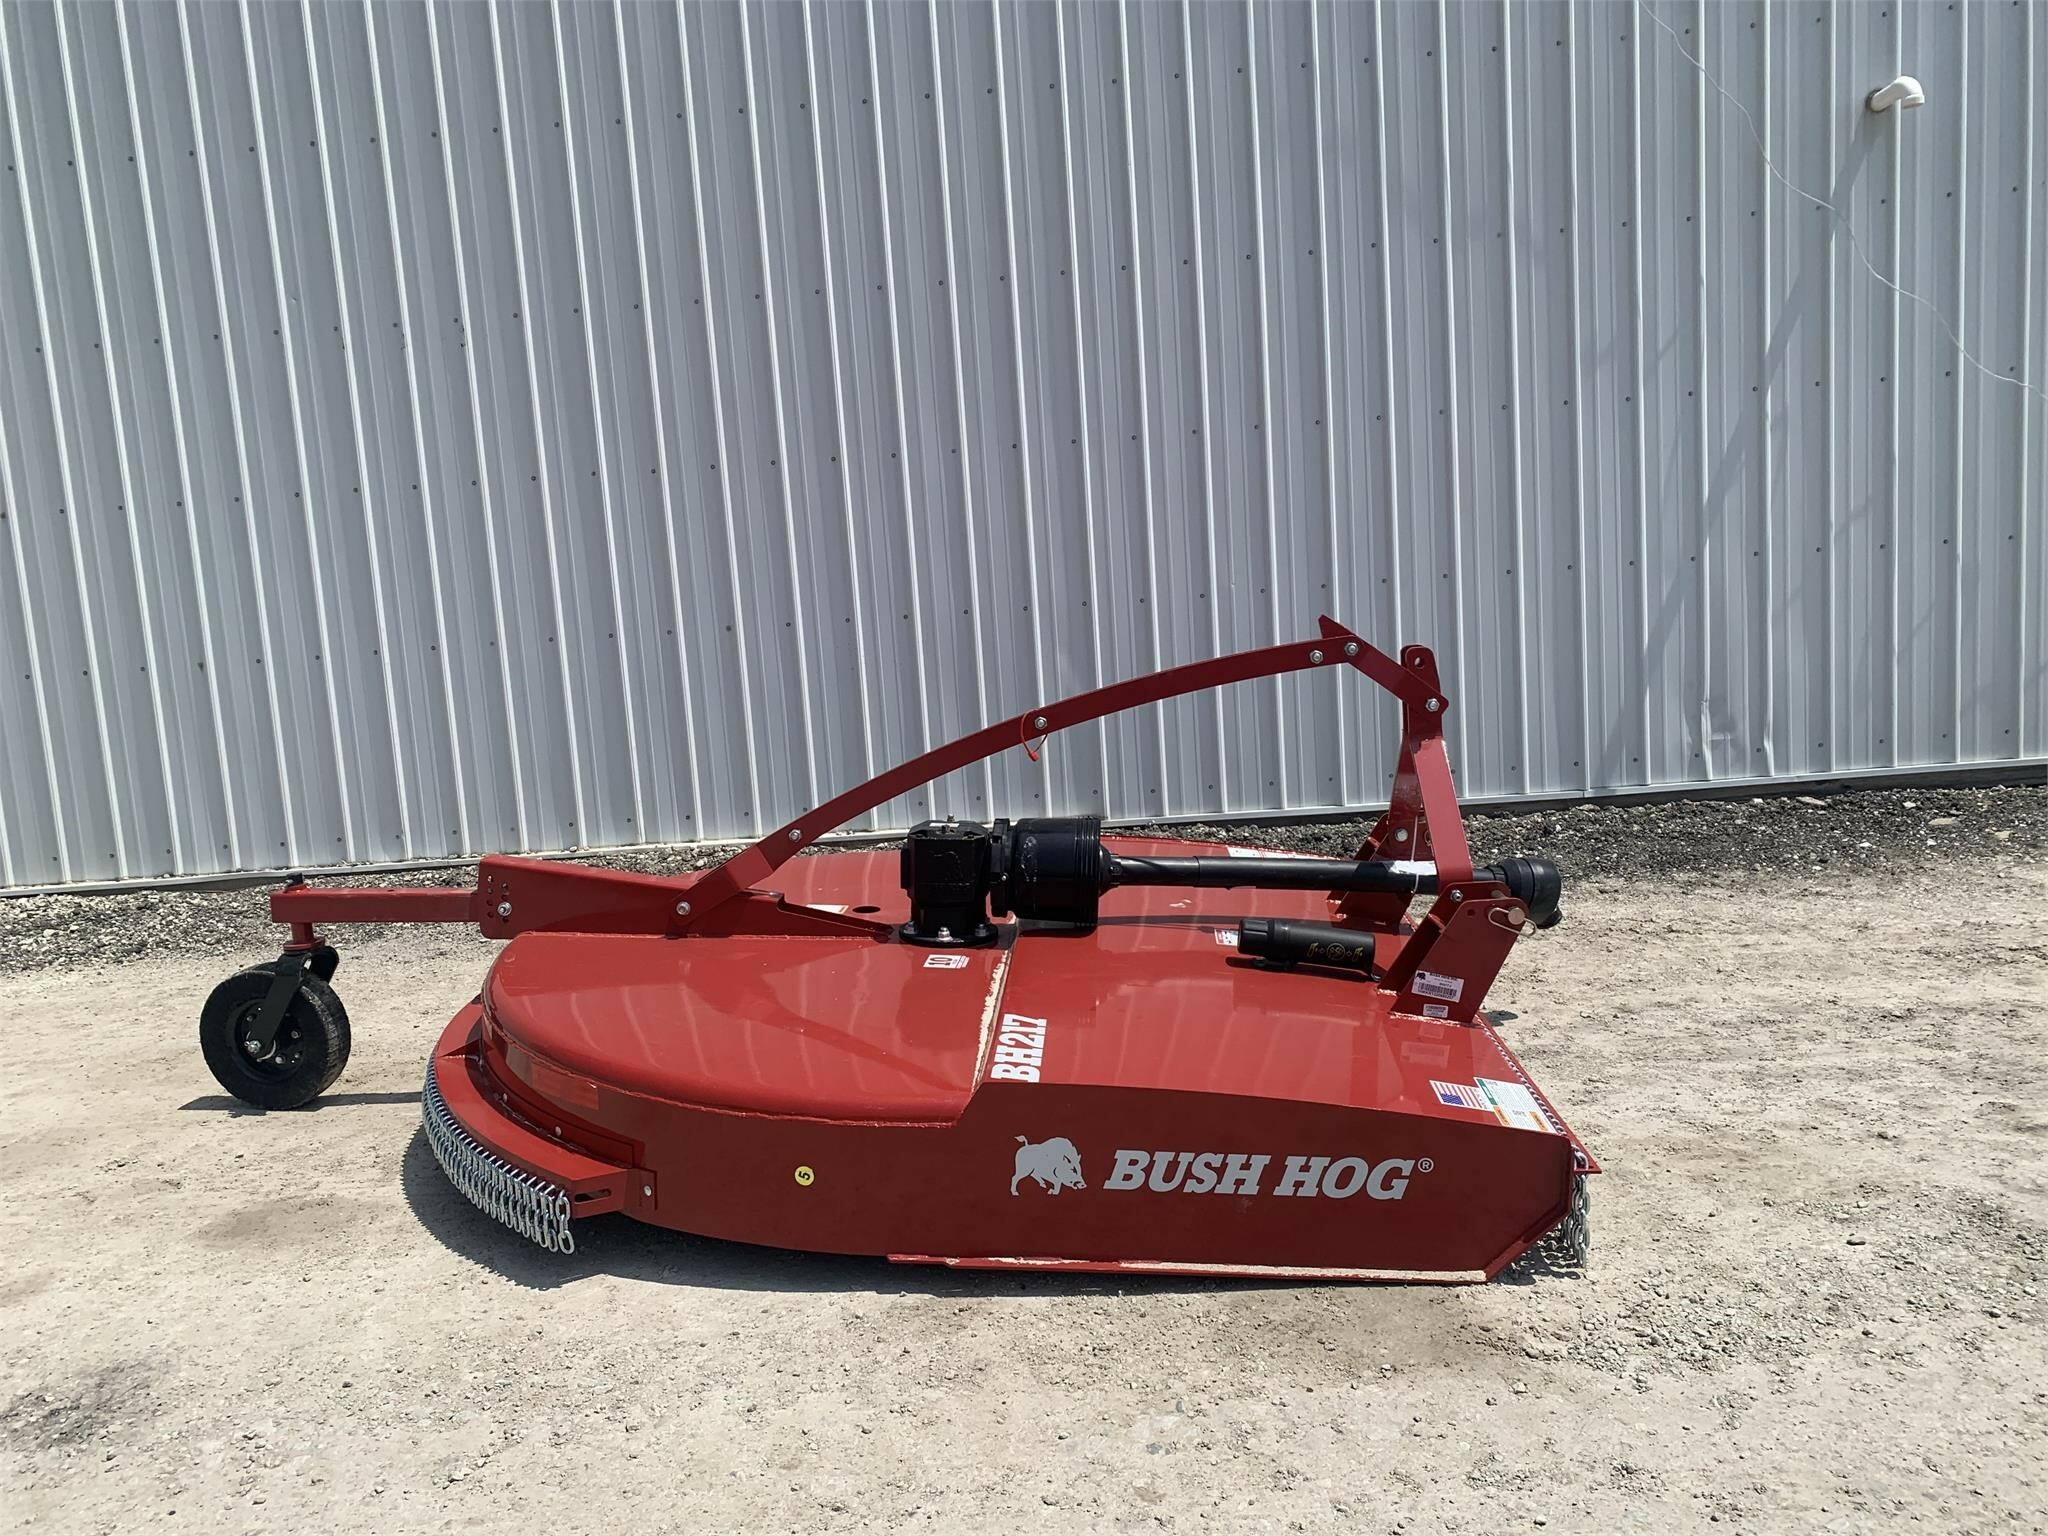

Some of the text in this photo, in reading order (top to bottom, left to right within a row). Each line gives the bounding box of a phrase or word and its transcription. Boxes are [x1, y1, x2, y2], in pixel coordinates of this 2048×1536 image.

[990, 1013, 1048, 1083] BH217
[798, 1171, 811, 1181] 5
[1103, 1149, 1272, 1195] BUSH
